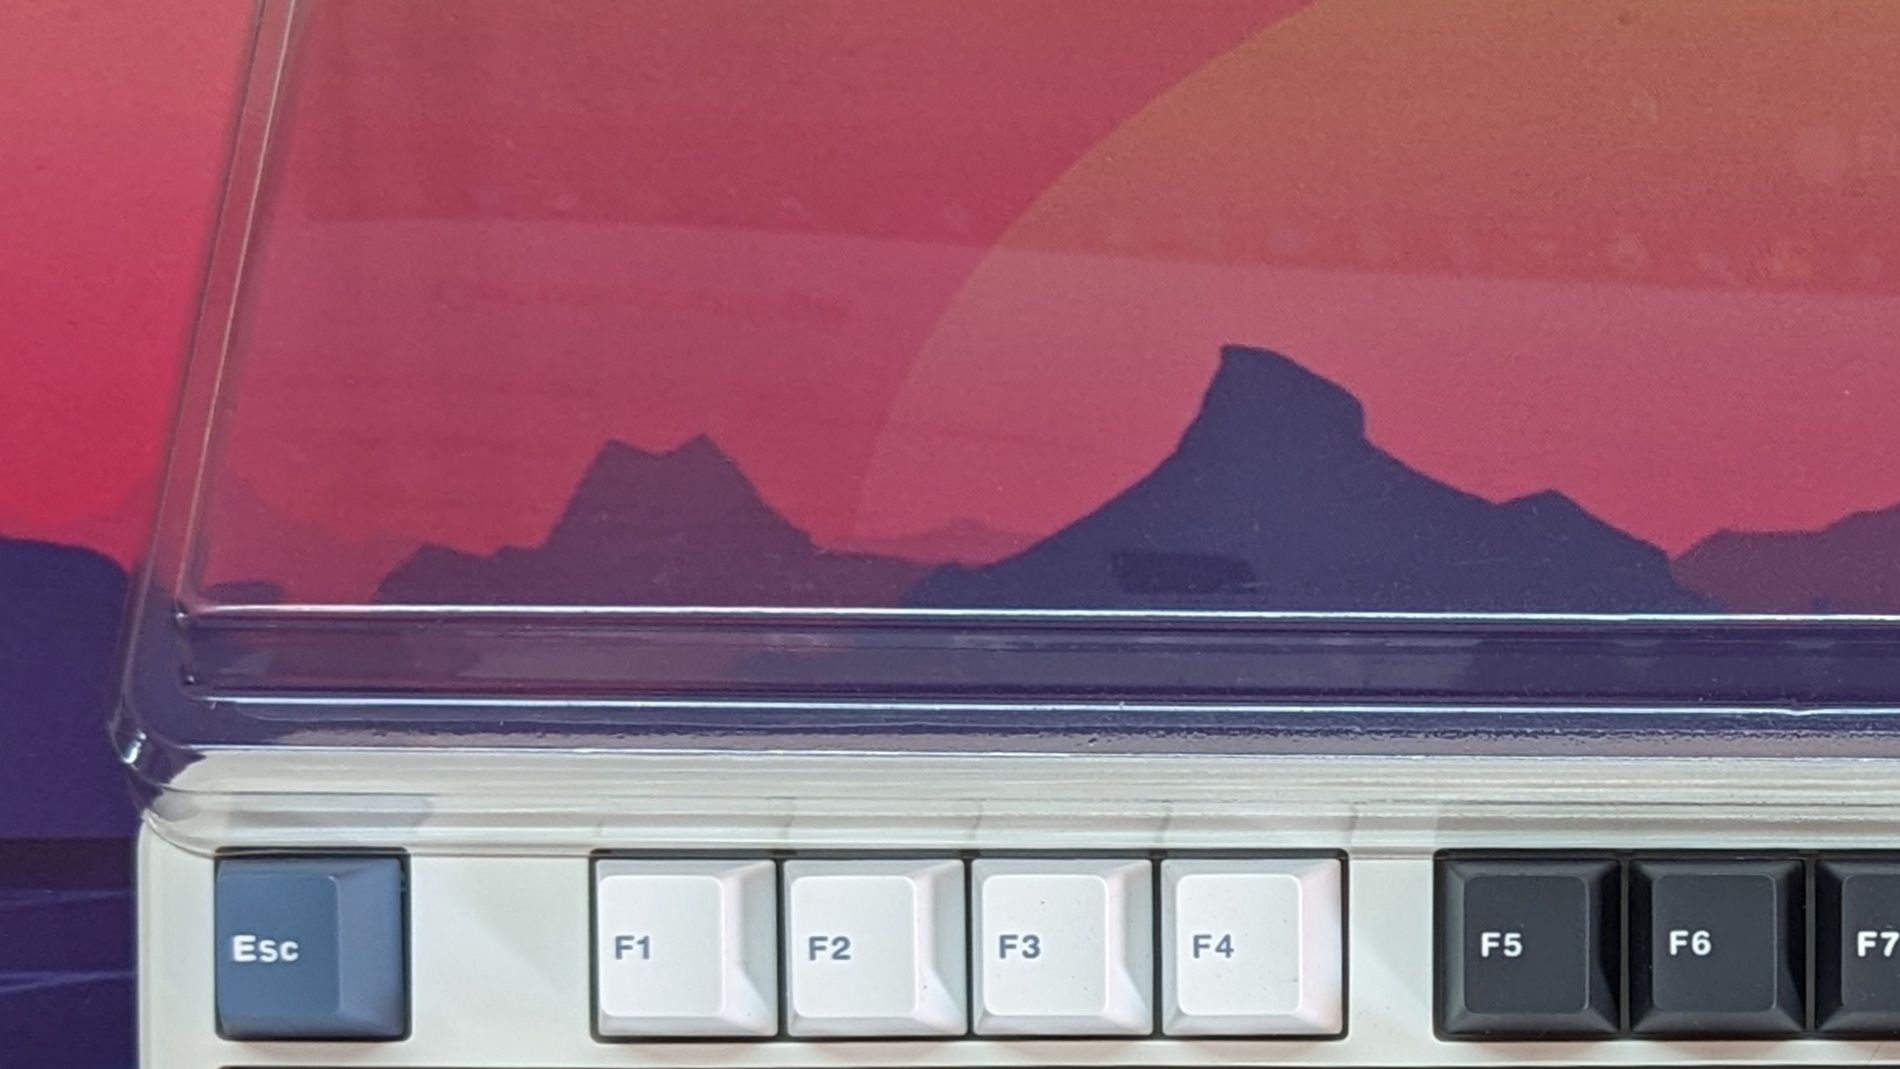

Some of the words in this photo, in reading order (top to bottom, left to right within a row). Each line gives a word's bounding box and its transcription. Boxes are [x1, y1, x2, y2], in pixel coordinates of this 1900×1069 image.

[232, 934, 299, 963] Esc
[614, 935, 650, 960] F1
[808, 935, 851, 961] F2
[999, 934, 1041, 960] F3
[1192, 933, 1235, 959] F4
[1481, 931, 1523, 958] F5
[1669, 929, 1712, 956] F6
[1857, 930, 1900, 957] F7
